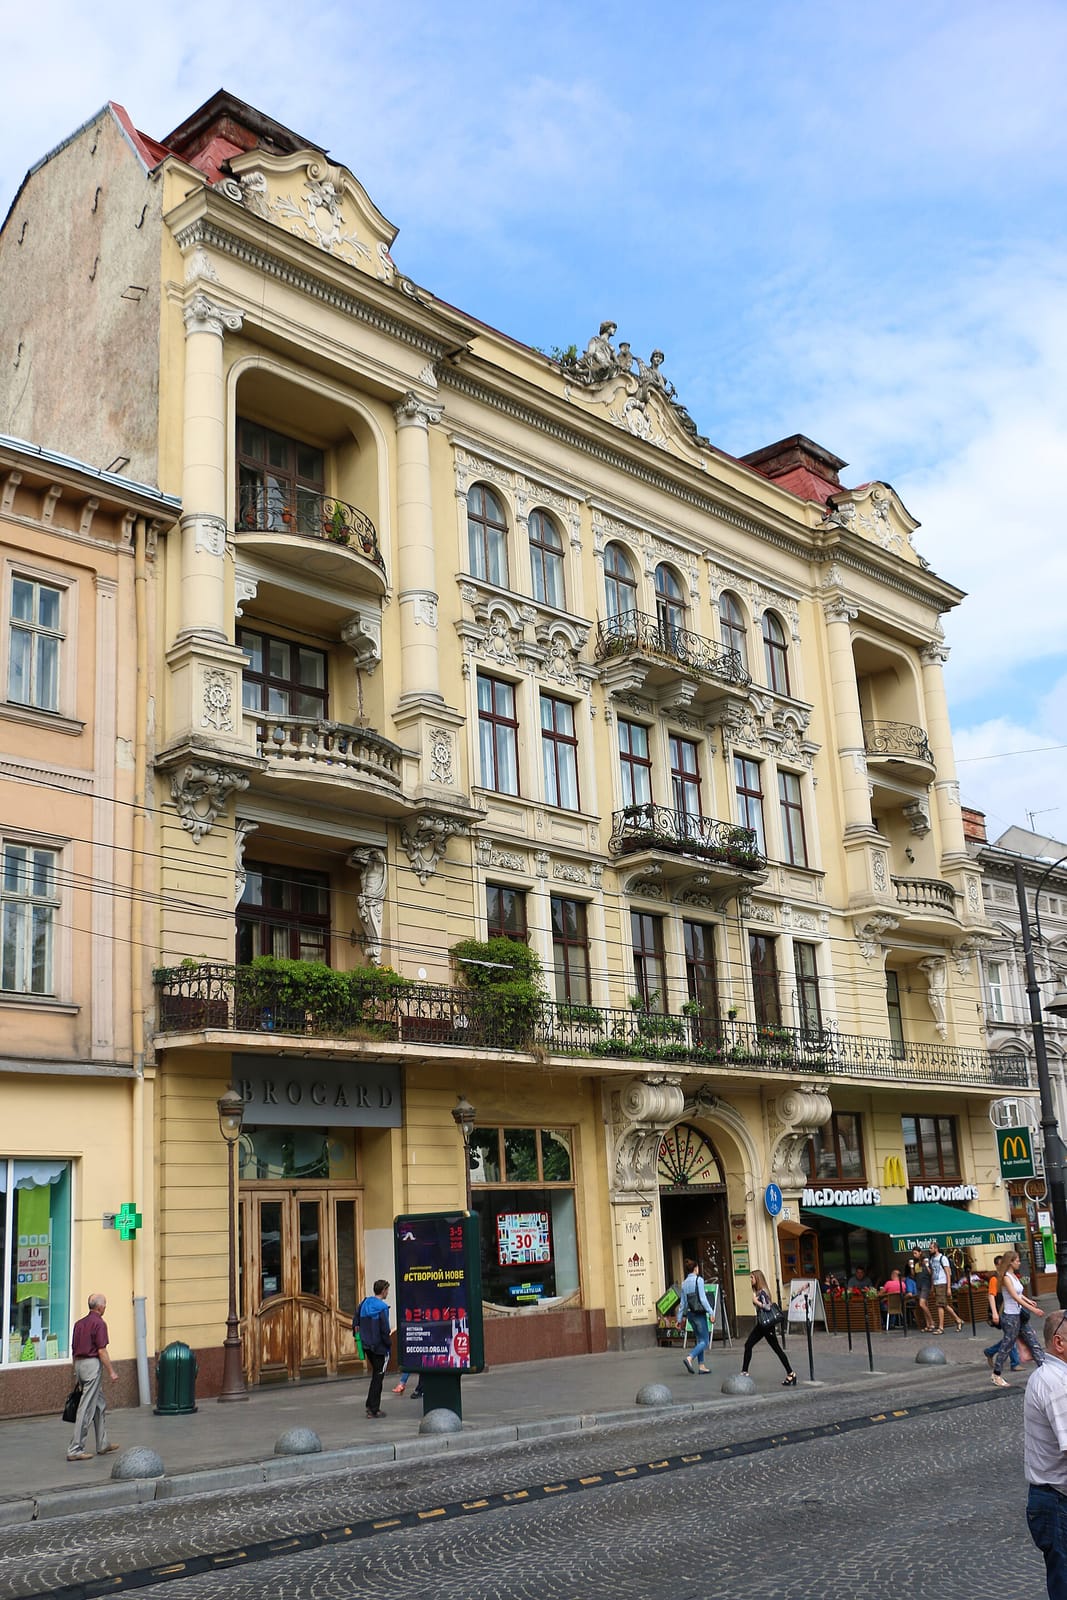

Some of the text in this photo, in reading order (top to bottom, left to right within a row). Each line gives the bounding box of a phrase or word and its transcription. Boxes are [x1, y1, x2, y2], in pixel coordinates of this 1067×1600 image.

[240, 1079, 393, 1108] BROCARD
[801, 1187, 881, 1206] McDonald's
[913, 1184, 980, 1202] McDonald's
[28, 1248, 39, 1258] 10
[404, 1268, 444, 1281] #СТВОРЮЙ
[445, 1270, 464, 1280] НОВЕ
[457, 1337, 468, 1347] 72
